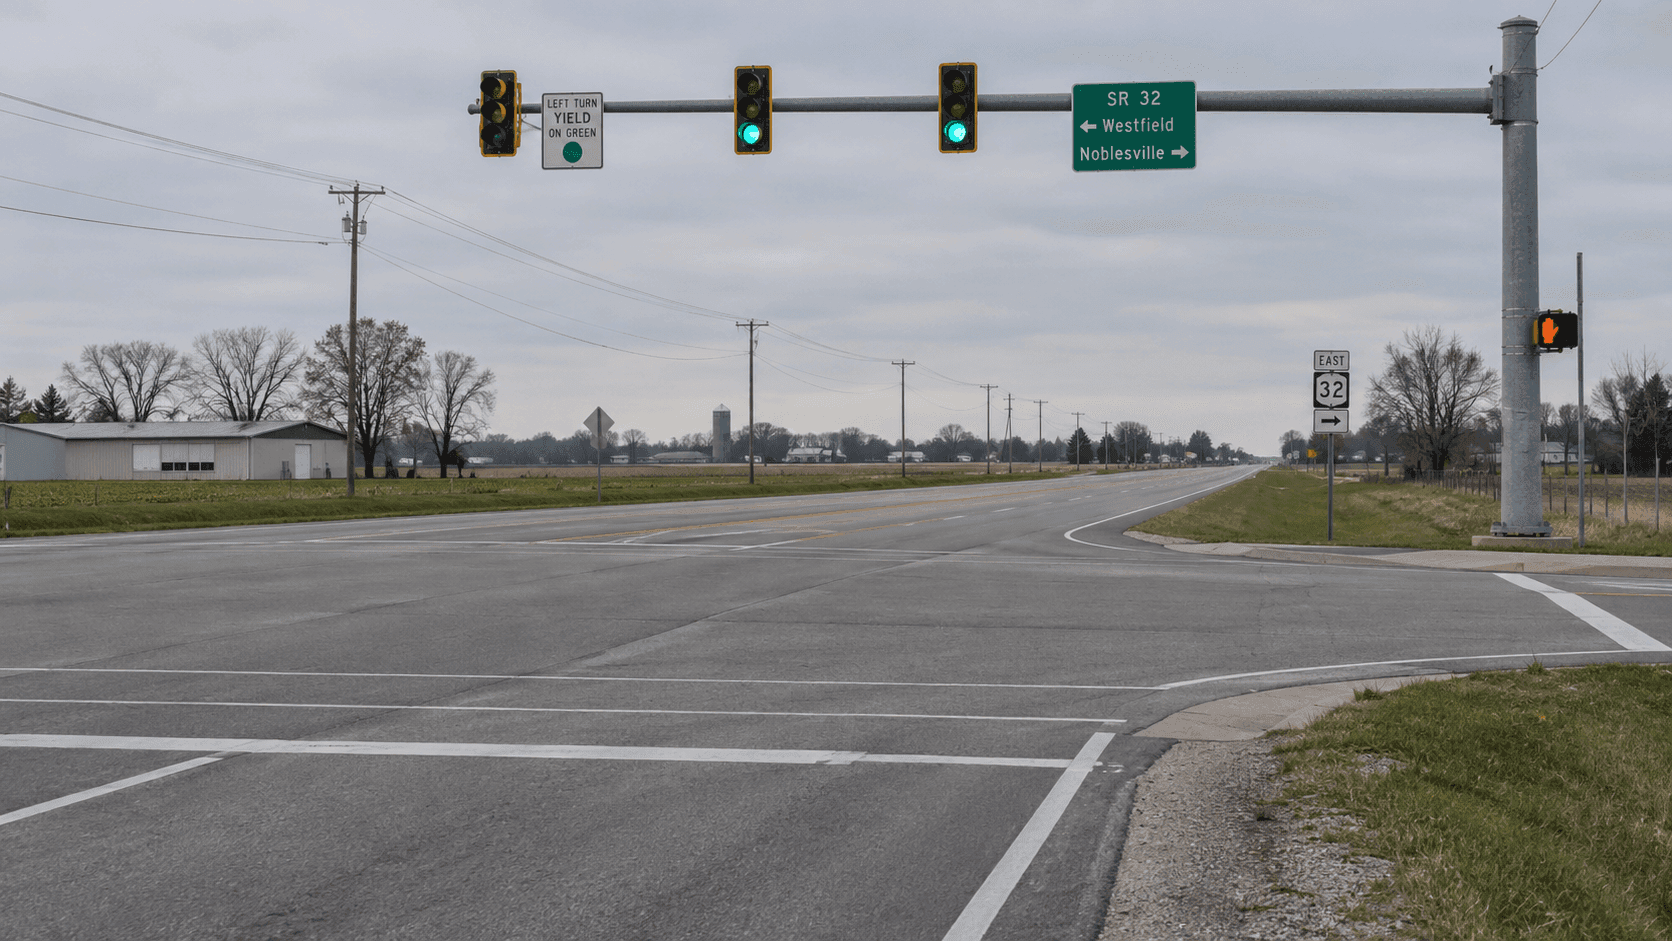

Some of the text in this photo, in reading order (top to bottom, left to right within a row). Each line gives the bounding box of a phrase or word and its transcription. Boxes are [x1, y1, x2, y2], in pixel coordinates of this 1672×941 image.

[547, 98, 598, 109] LEFT TURN
[1107, 90, 1161, 106] SR 32
[554, 112, 591, 124] YIELD
[1102, 117, 1174, 133] Westfield
[548, 128, 597, 138] ON GREEN
[1080, 145, 1165, 161] Noblesville
[1319, 355, 1345, 366] EAST
[1319, 380, 1343, 398] 32
